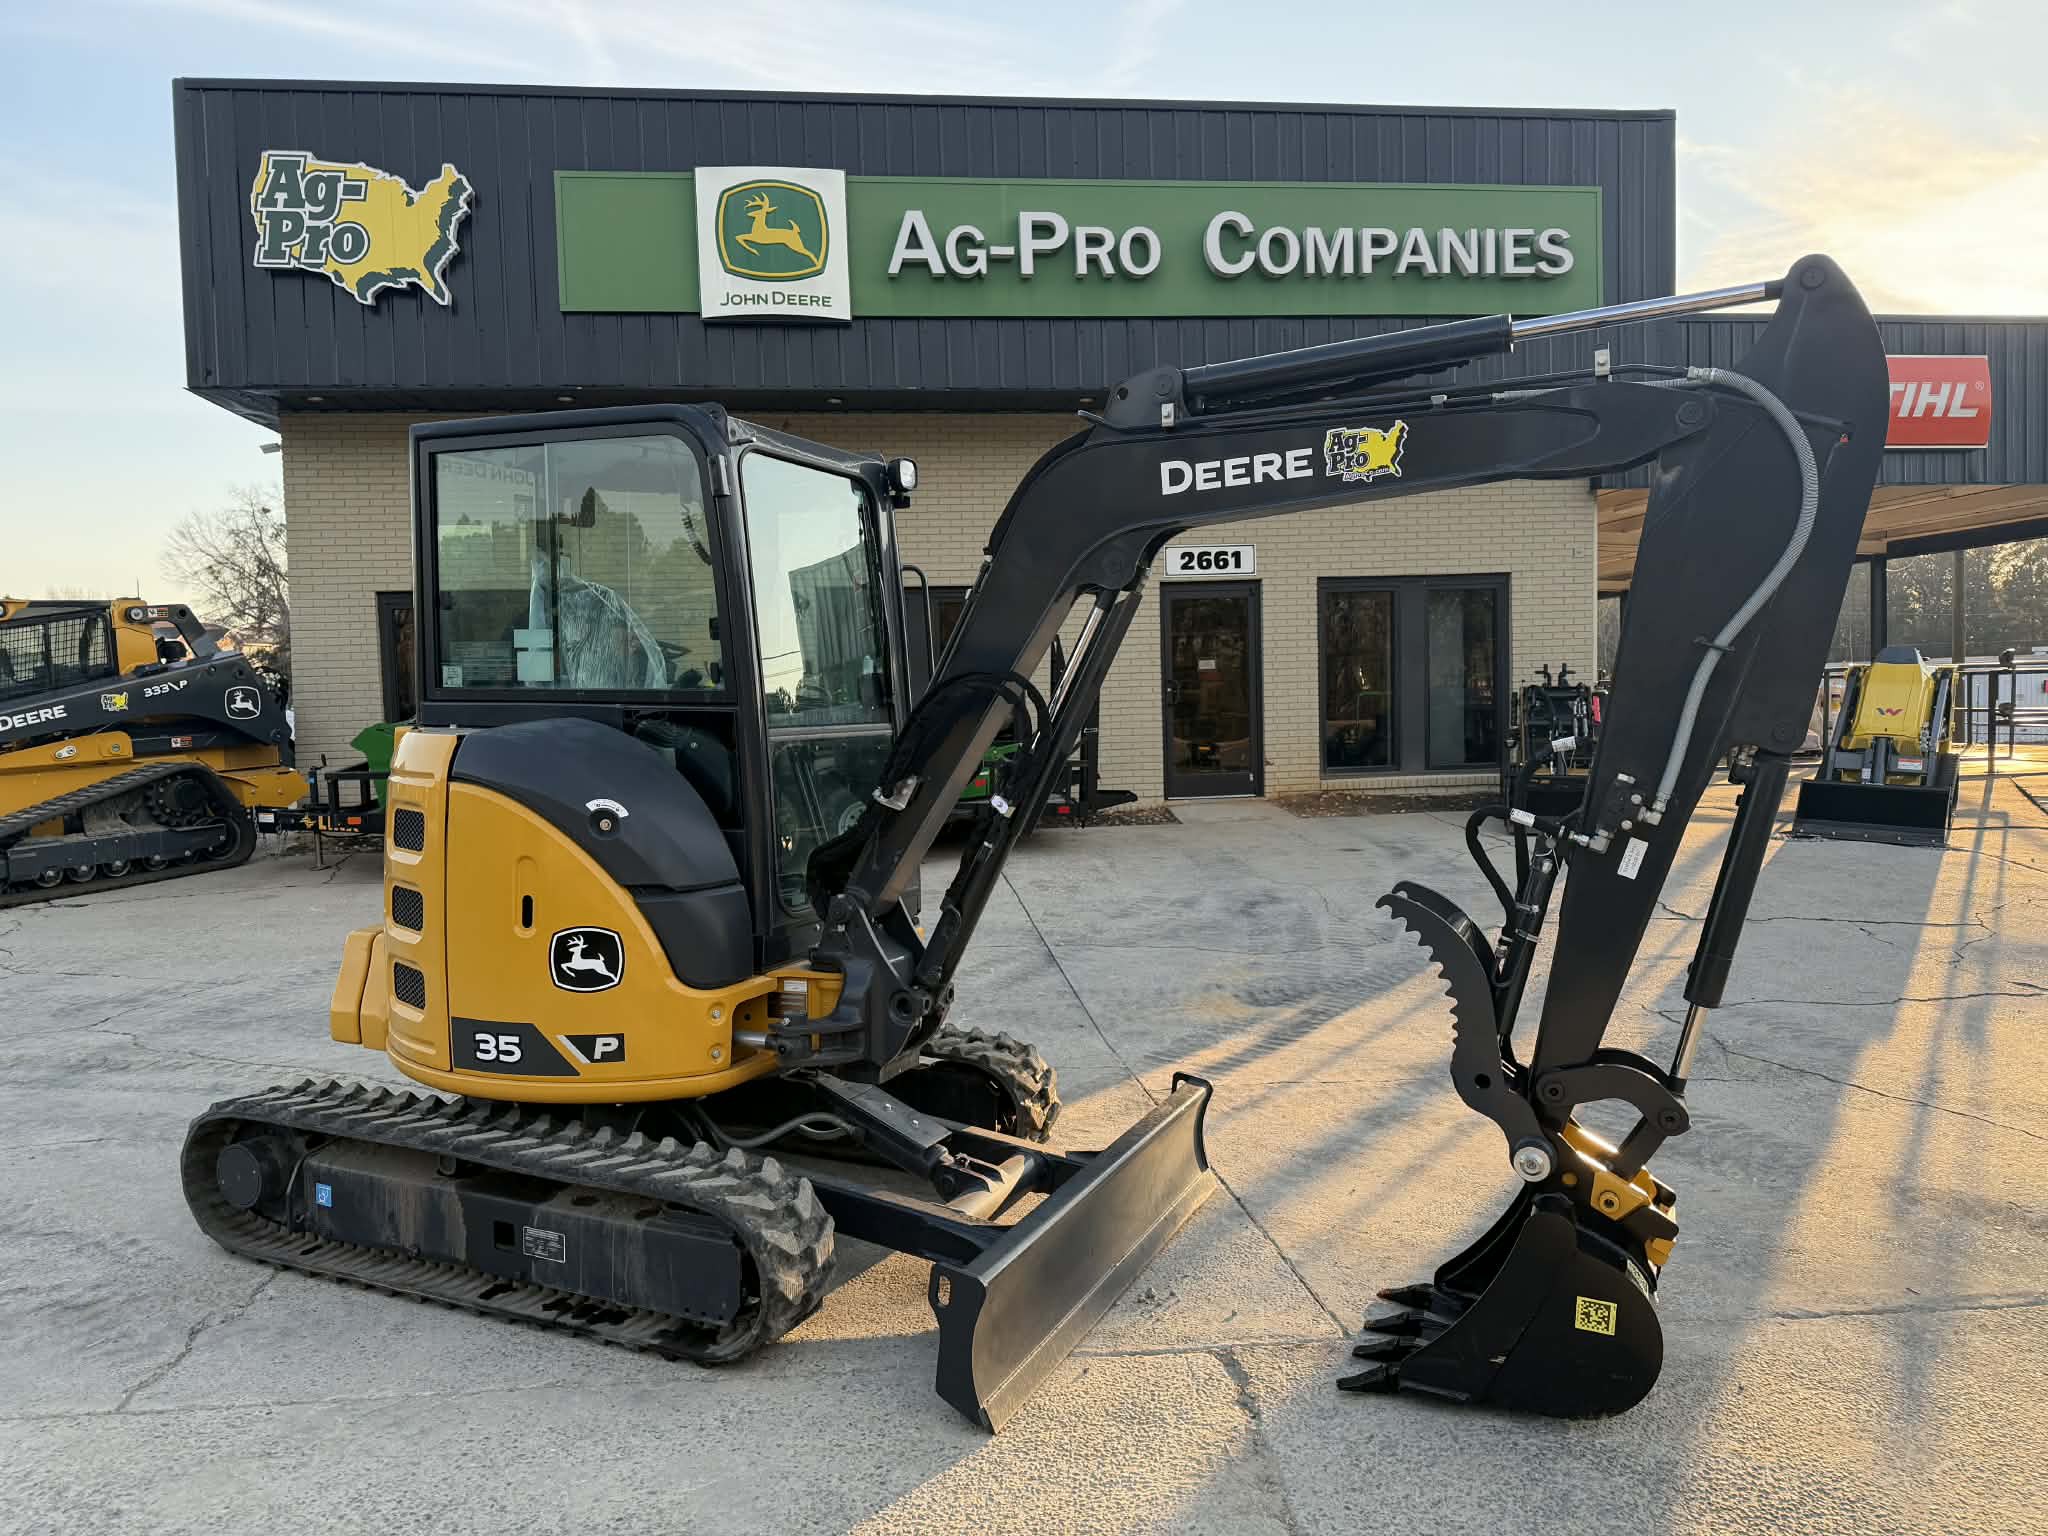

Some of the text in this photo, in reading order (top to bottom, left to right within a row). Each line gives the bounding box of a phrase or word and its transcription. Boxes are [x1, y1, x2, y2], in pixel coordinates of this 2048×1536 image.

[259, 156, 367, 223] Ag-
[259, 210, 369, 264] Pro
[888, 210, 1574, 278] AG-PRO COMPANIES
[720, 291, 832, 308] JOHN DEERE
[1890, 382, 1979, 418] IHL
[1329, 430, 1368, 456] Ag-
[1160, 447, 1314, 495] DEERE
[1329, 451, 1370, 473] Pro
[1179, 551, 1242, 571] 2661
[0, 704, 67, 732] DEERE
[475, 1032, 619, 1063] 35 P
